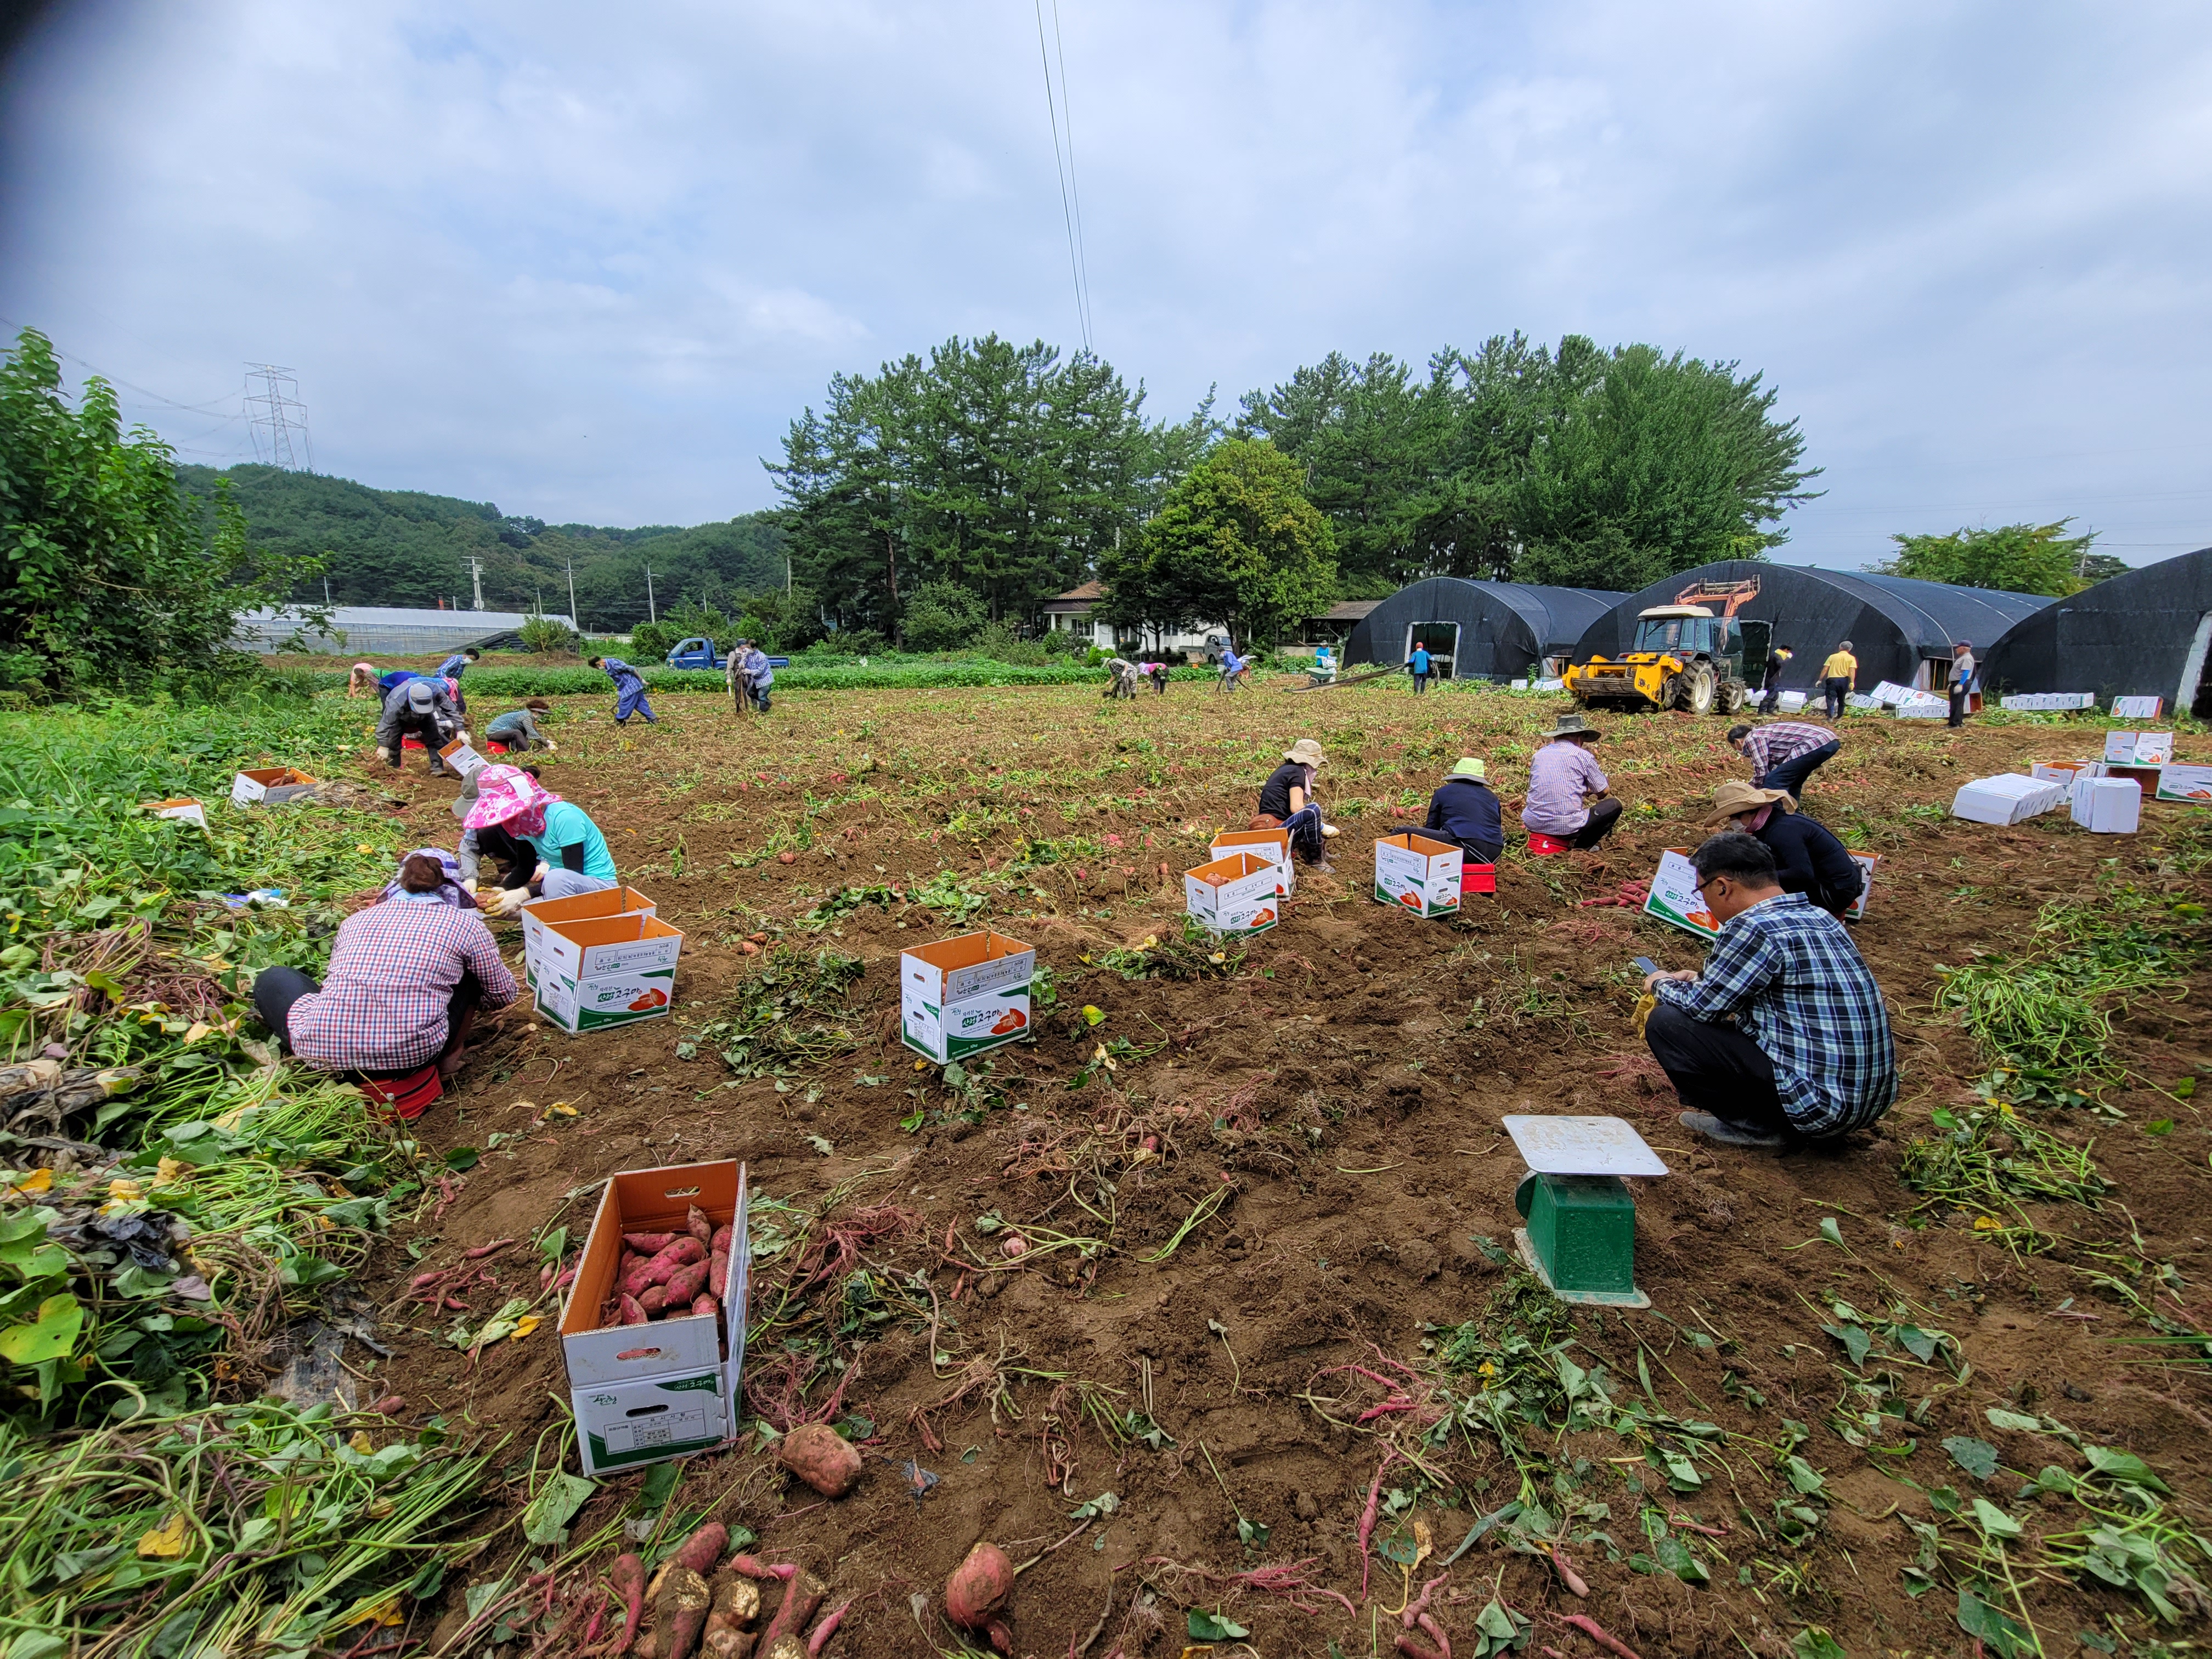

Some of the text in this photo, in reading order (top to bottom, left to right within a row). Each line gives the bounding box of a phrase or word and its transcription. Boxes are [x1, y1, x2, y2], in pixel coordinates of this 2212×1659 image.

[1678, 895, 1697, 906] 고구마
[1240, 909, 1255, 920] 고구마
[614, 988, 639, 999] 고구마
[963, 1009, 1000, 1026] 산청 고구마
[689, 1379, 710, 1388] 고구마
